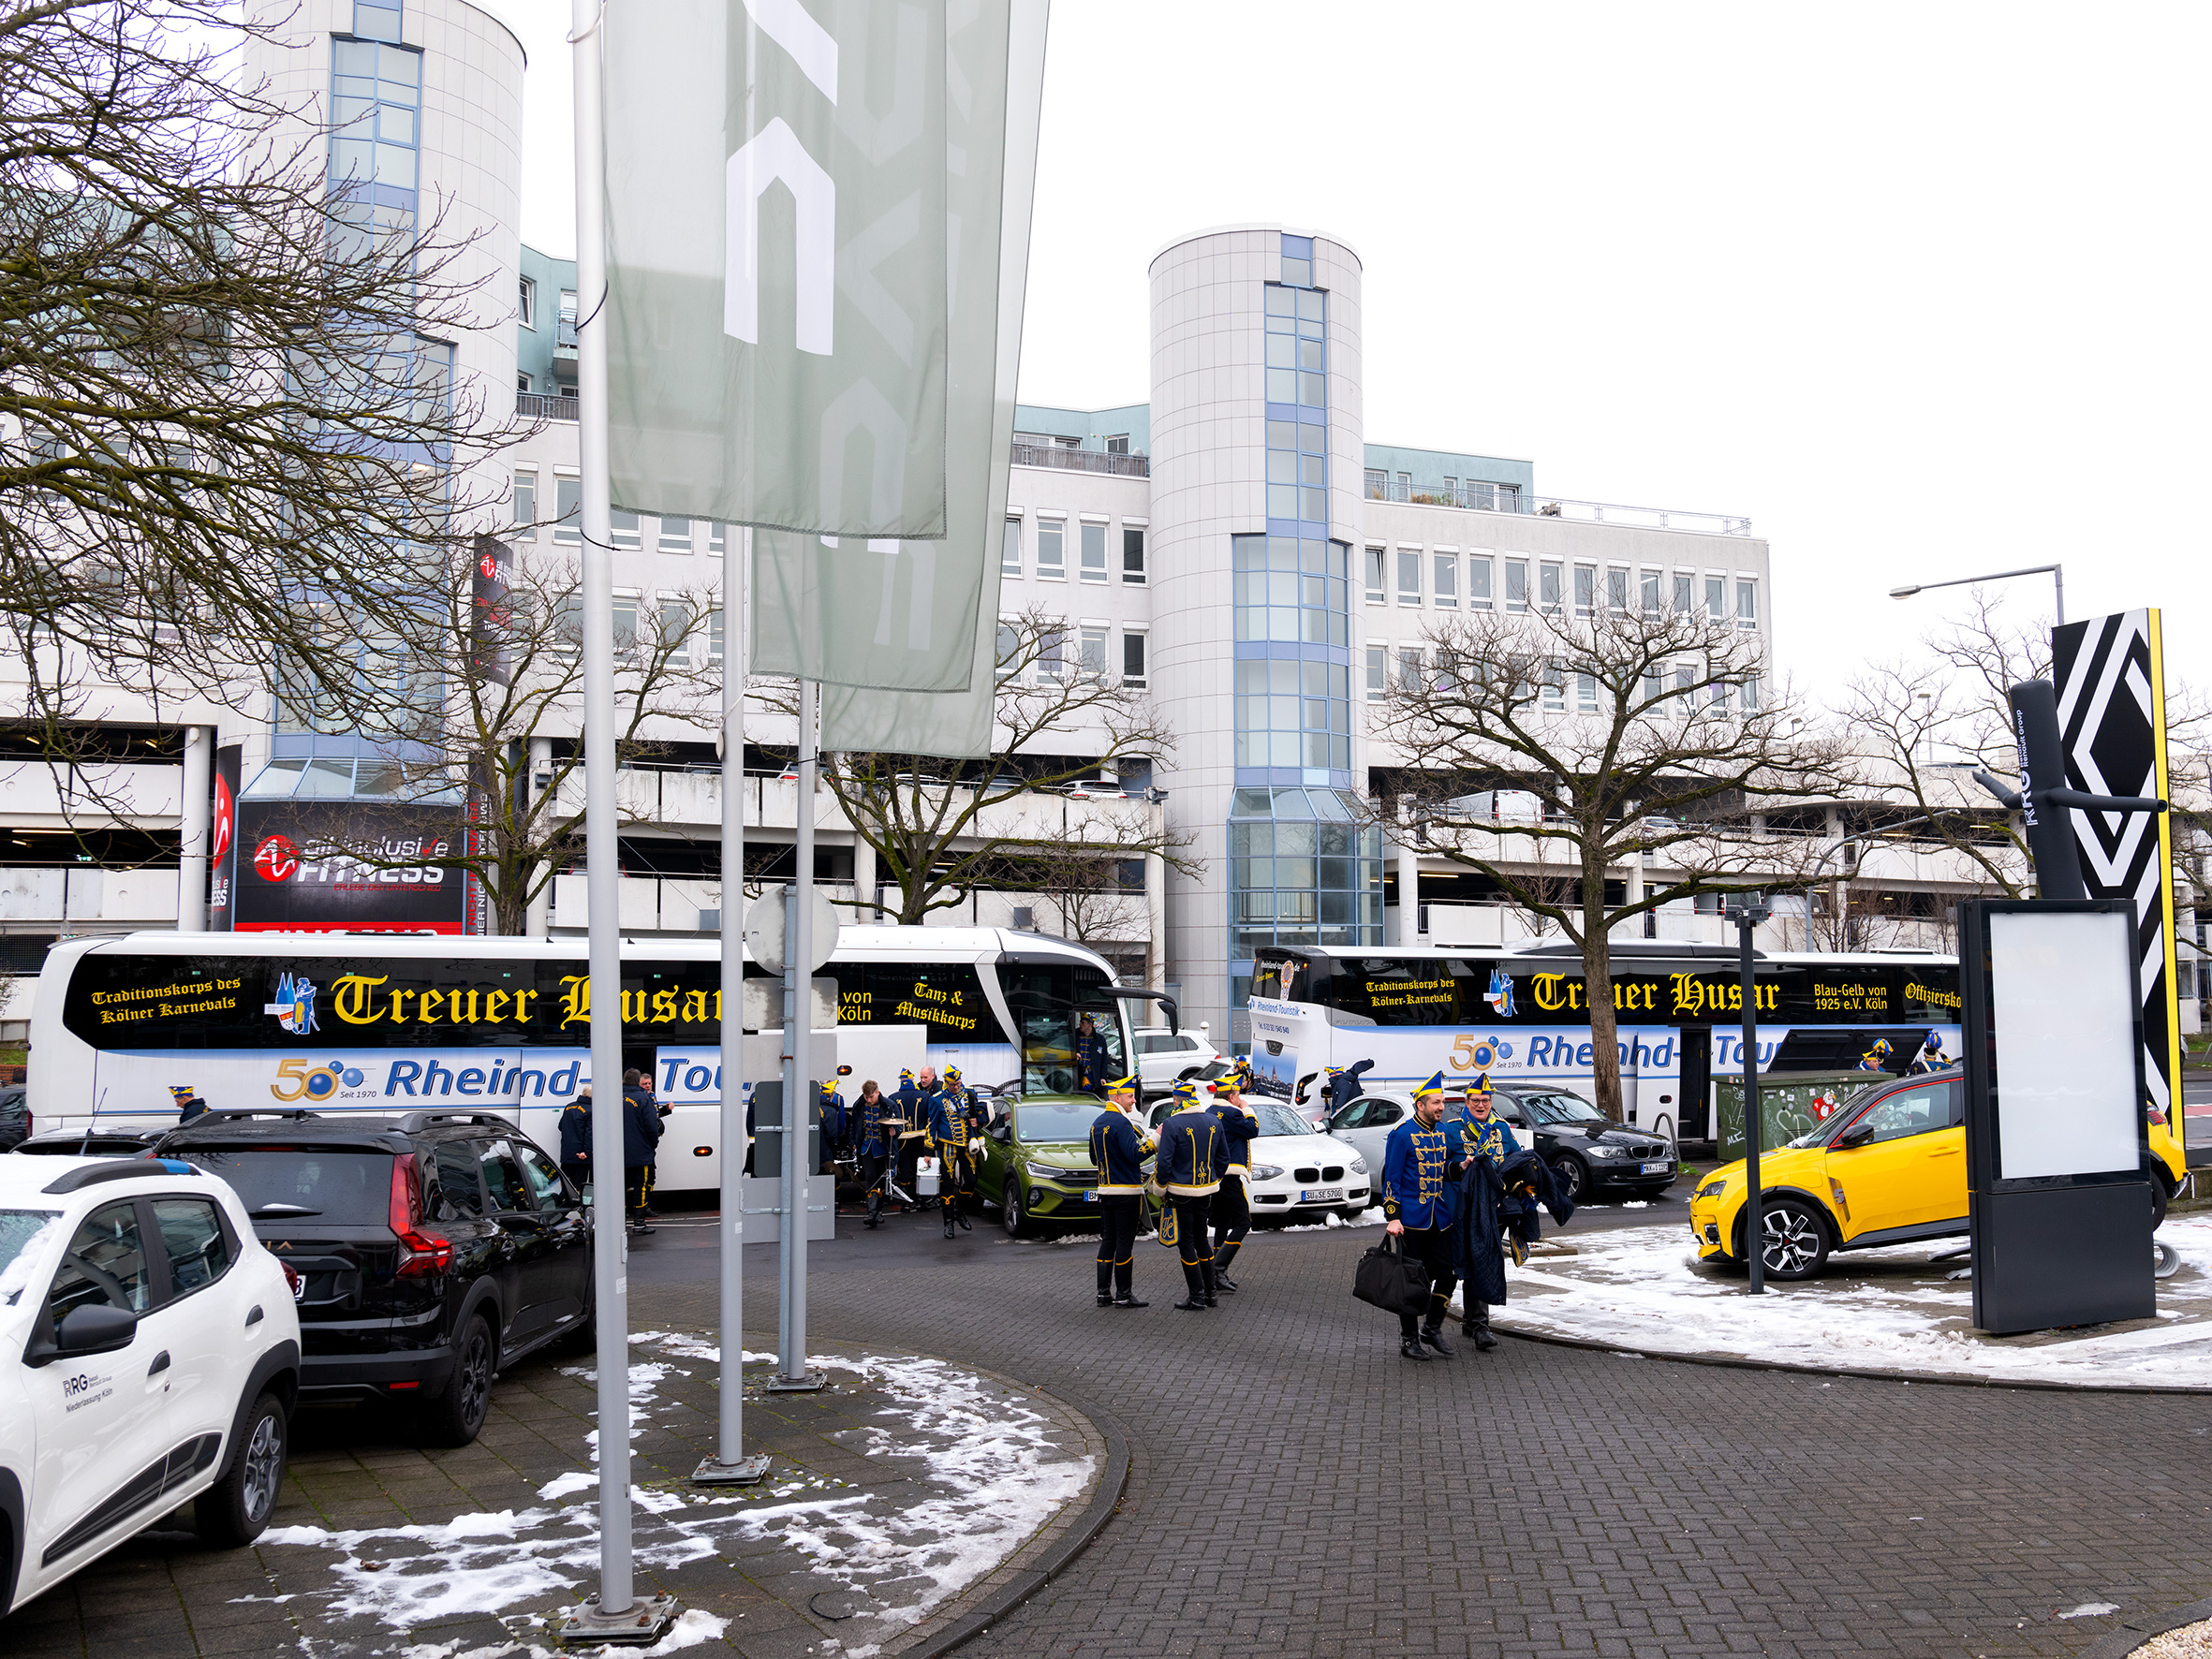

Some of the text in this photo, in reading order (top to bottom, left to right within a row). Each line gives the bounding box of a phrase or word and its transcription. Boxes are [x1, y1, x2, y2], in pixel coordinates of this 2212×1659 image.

[2016, 709, 2029, 768] Renault Group
[2021, 770, 2039, 826] RRG
[367, 883, 385, 891] DEN
[91, 977, 241, 1006] Traditionskorps des
[843, 991, 872, 1004] von
[914, 982, 964, 1006] Tanz &
[1365, 978, 1455, 992] Traditionskorps des
[1814, 984, 1886, 996] Blau-Gelb von
[99, 997, 236, 1024] Kölner Karnevals
[330, 975, 538, 1025] Treuer
[1816, 997, 1888, 1010] 1925 e.V. Köln
[837, 1006, 871, 1021] Köln
[894, 1001, 977, 1030] Musikkorps
[1450, 1035, 1496, 1070] 50
[270, 1059, 339, 1102] 50
[1327, 1190, 1342, 1198] 5700
[62, 1373, 89, 1398] RRG
